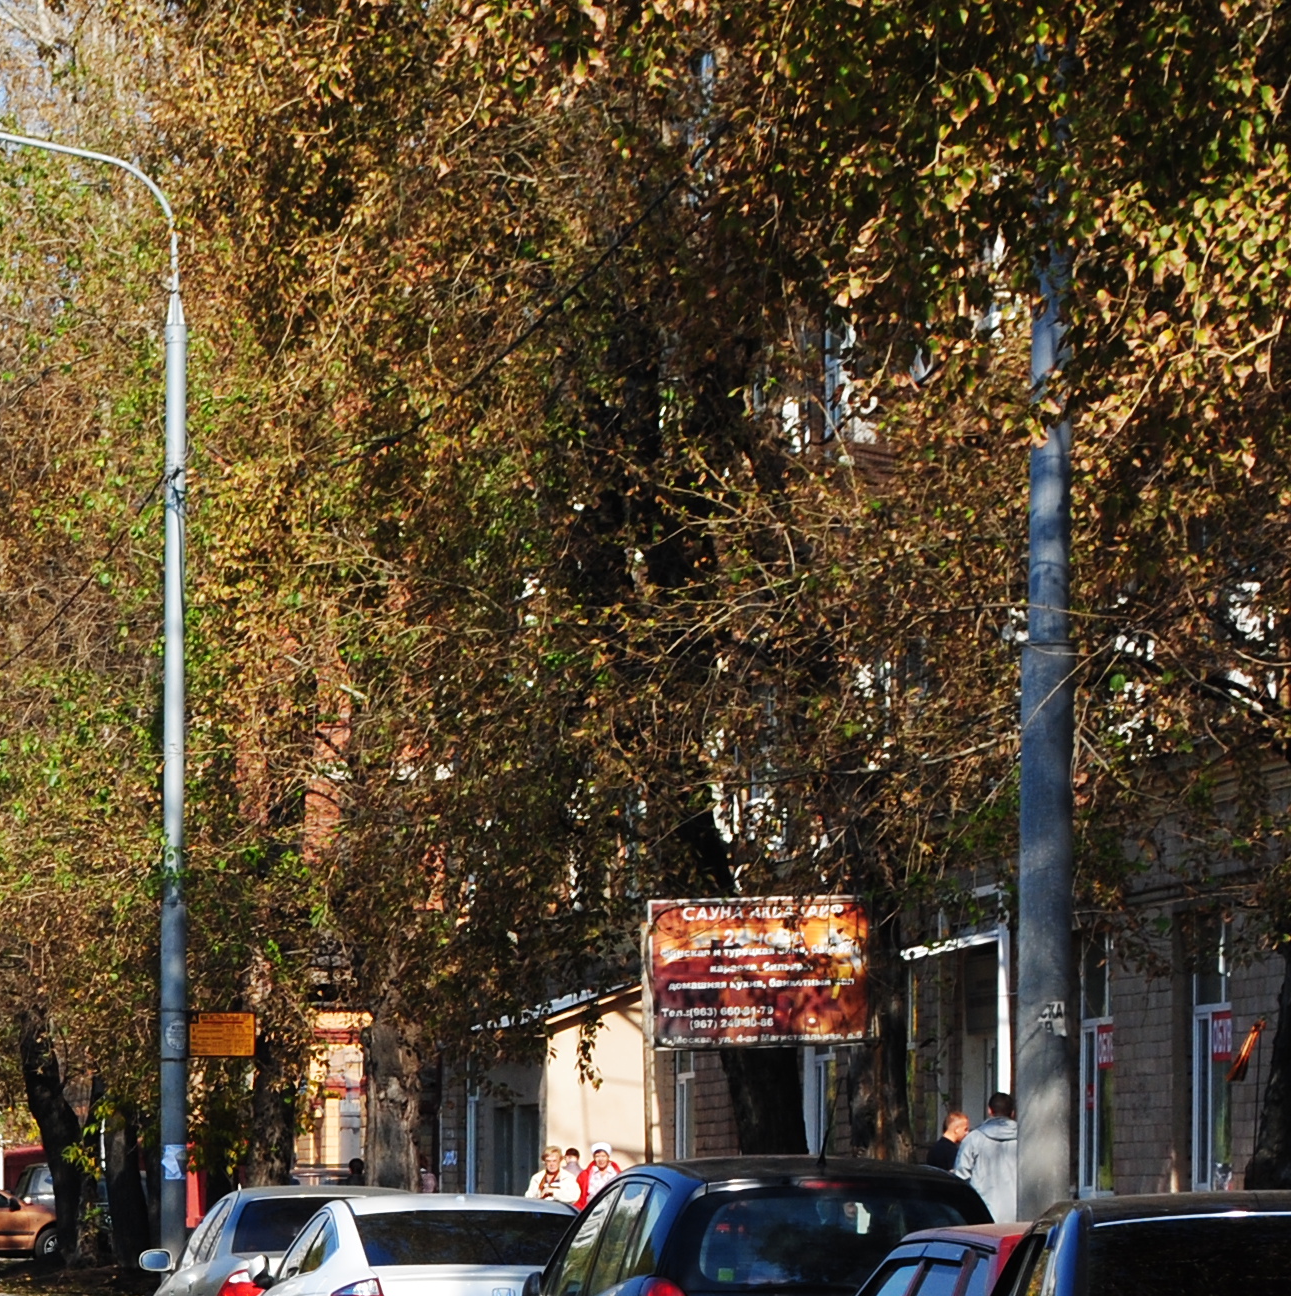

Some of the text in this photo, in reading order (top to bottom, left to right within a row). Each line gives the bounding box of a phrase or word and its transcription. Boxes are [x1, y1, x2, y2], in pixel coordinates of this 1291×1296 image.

[682, 906, 743, 921] САУНА
[713, 949, 721, 957] и
[723, 947, 775, 958] турецкая
[668, 981, 727, 991] домашняя
[718, 1036, 734, 1045] ул.
